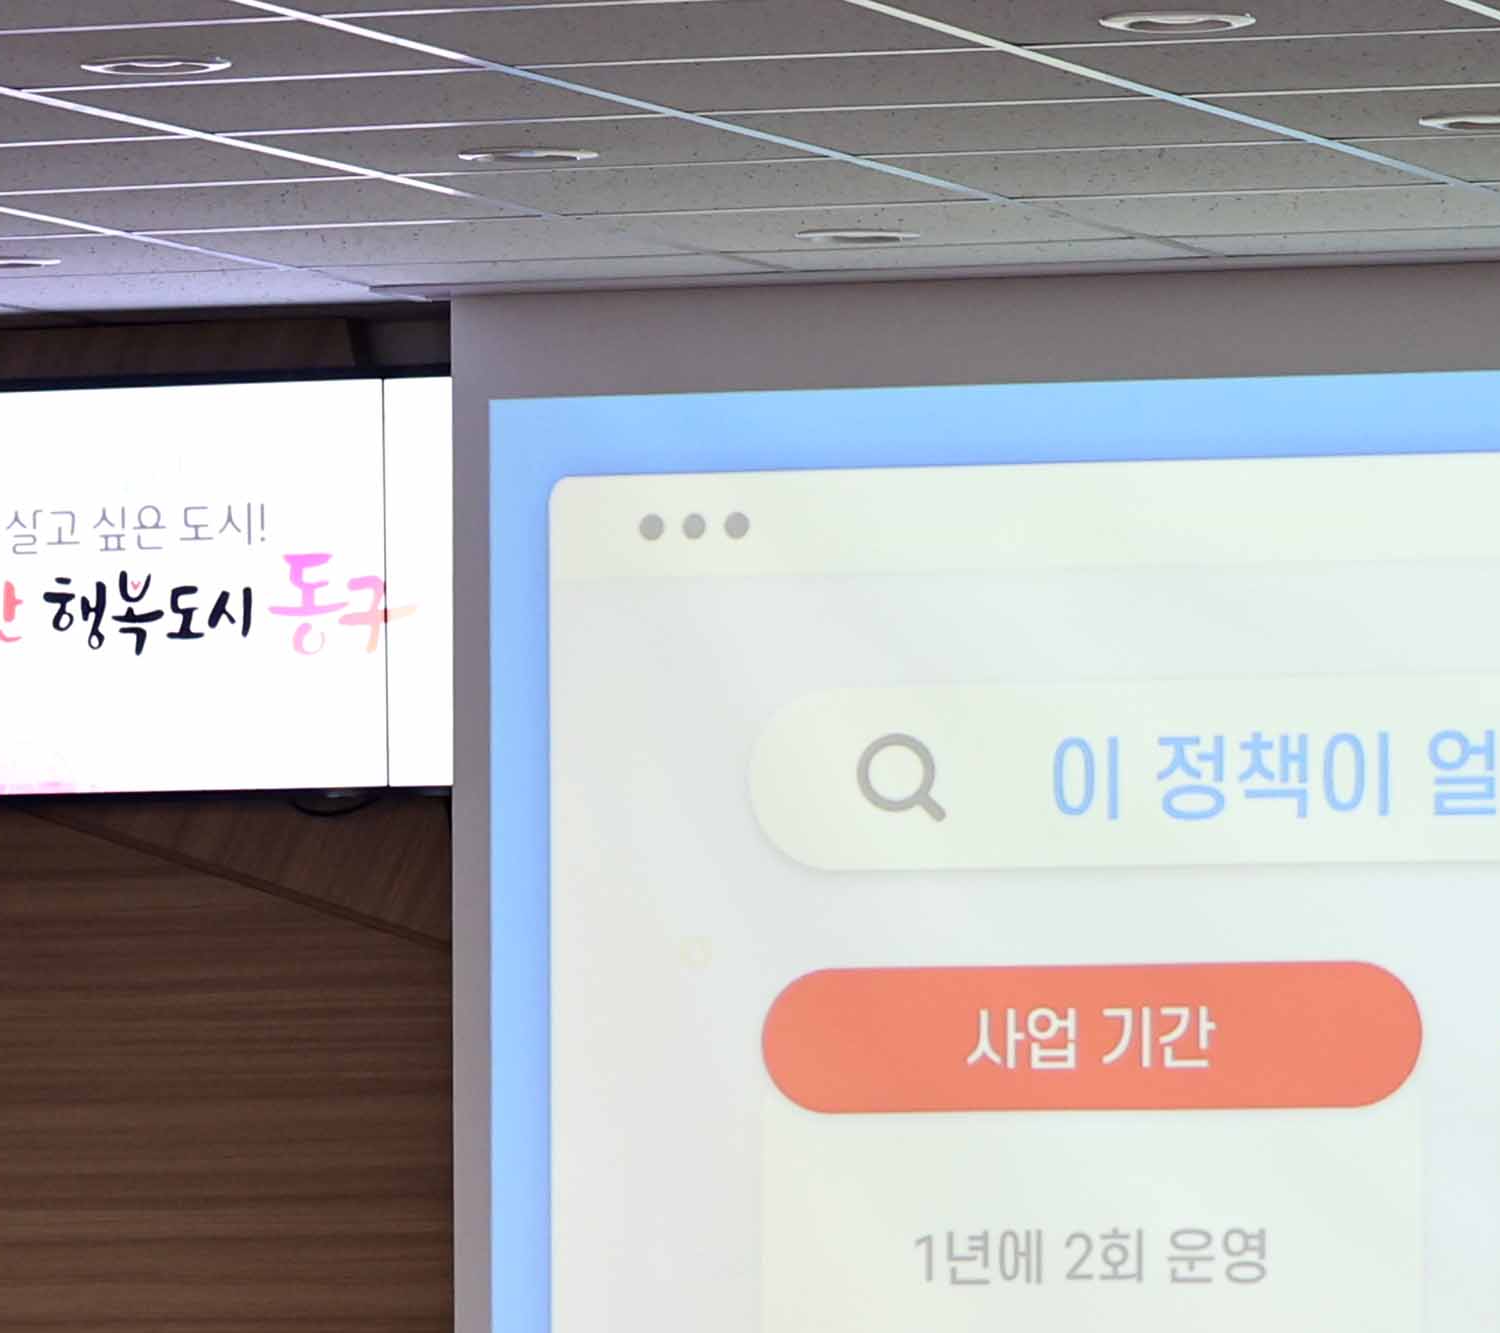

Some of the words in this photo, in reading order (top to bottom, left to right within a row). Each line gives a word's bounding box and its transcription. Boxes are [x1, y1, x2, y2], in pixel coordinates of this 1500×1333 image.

[6, 510, 80, 555] 살고
[94, 505, 166, 552] 싶은
[180, 502, 268, 545] 도시!
[43, 571, 252, 655] 행복도시
[268, 552, 418, 656] 동구
[1053, 736, 1119, 820] 이
[1157, 731, 1389, 821] 정책이
[968, 1008, 1076, 1070] 사업
[1103, 1006, 1216, 1068] 기간
[916, 1229, 1042, 1285] 1년에
[1065, 1228, 1143, 1283] 2회
[1168, 1228, 1267, 1284] 운영
